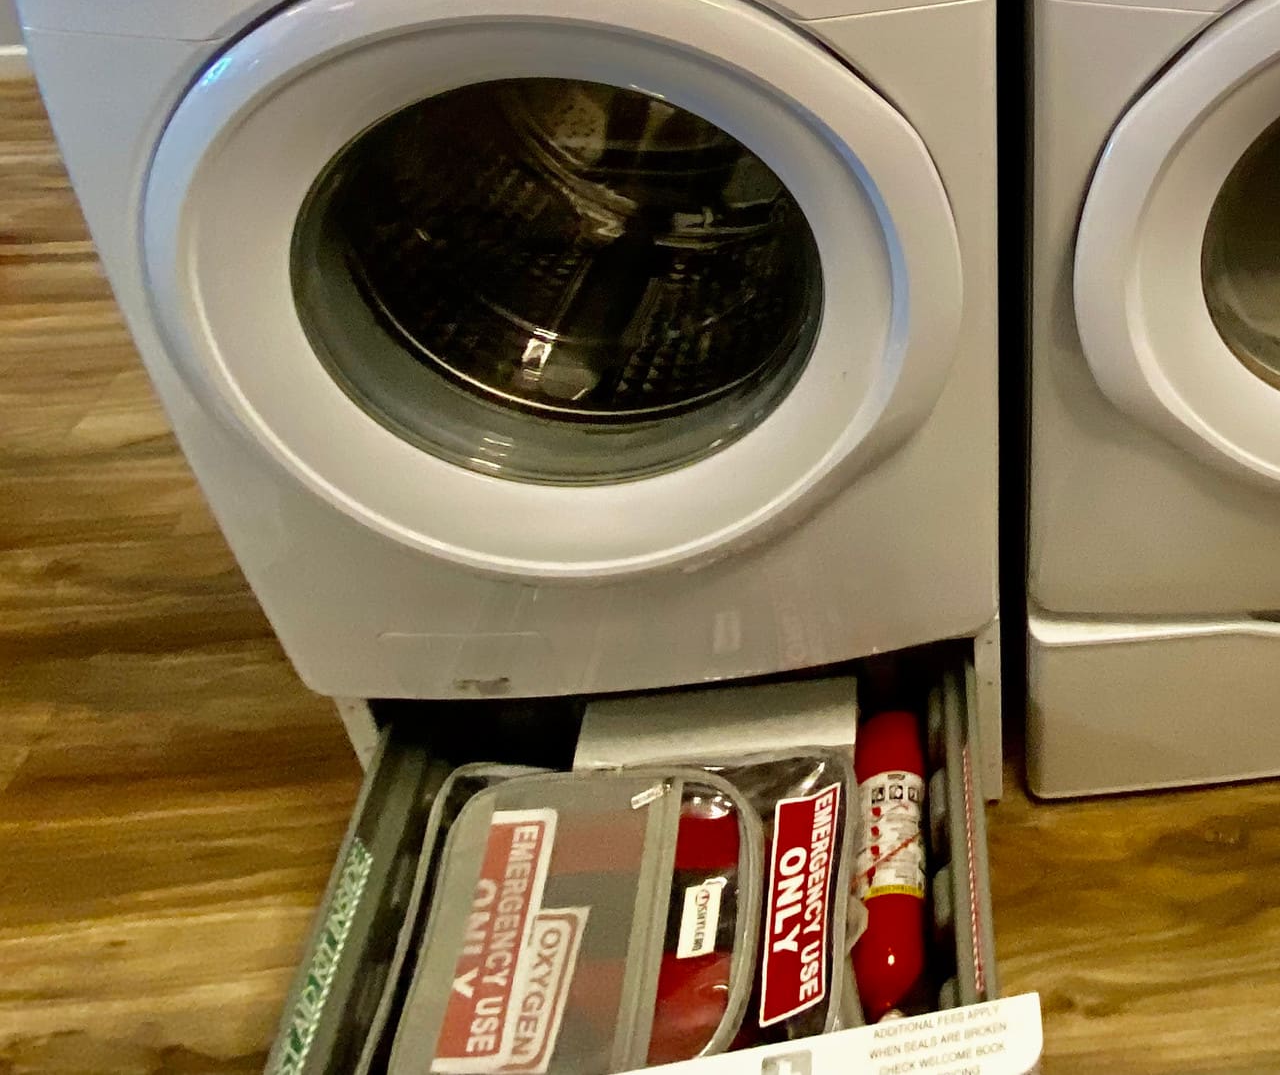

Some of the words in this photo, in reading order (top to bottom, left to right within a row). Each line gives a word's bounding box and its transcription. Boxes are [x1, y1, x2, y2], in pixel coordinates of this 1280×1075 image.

[803, 790, 833, 934] EMERGENCY
[482, 824, 539, 987] EMERGENCY
[772, 846, 807, 954] ONLY
[512, 927, 561, 1055] OXYGEN
[799, 939, 820, 1002] USE
[466, 996, 504, 1053] USE
[869, 1045, 905, 1060] WHEN
[904, 1036, 937, 1053] SEALS
[940, 1031, 961, 1044] ARE
[963, 1022, 1007, 1040] BROKEN
[873, 1017, 934, 1039] ADDITIONAL
[967, 1006, 999, 1021] APPLY
[879, 1062, 915, 1075] CHECK
[919, 1051, 972, 1069] WELCOME
[975, 1042, 1005, 1057] BOOK
